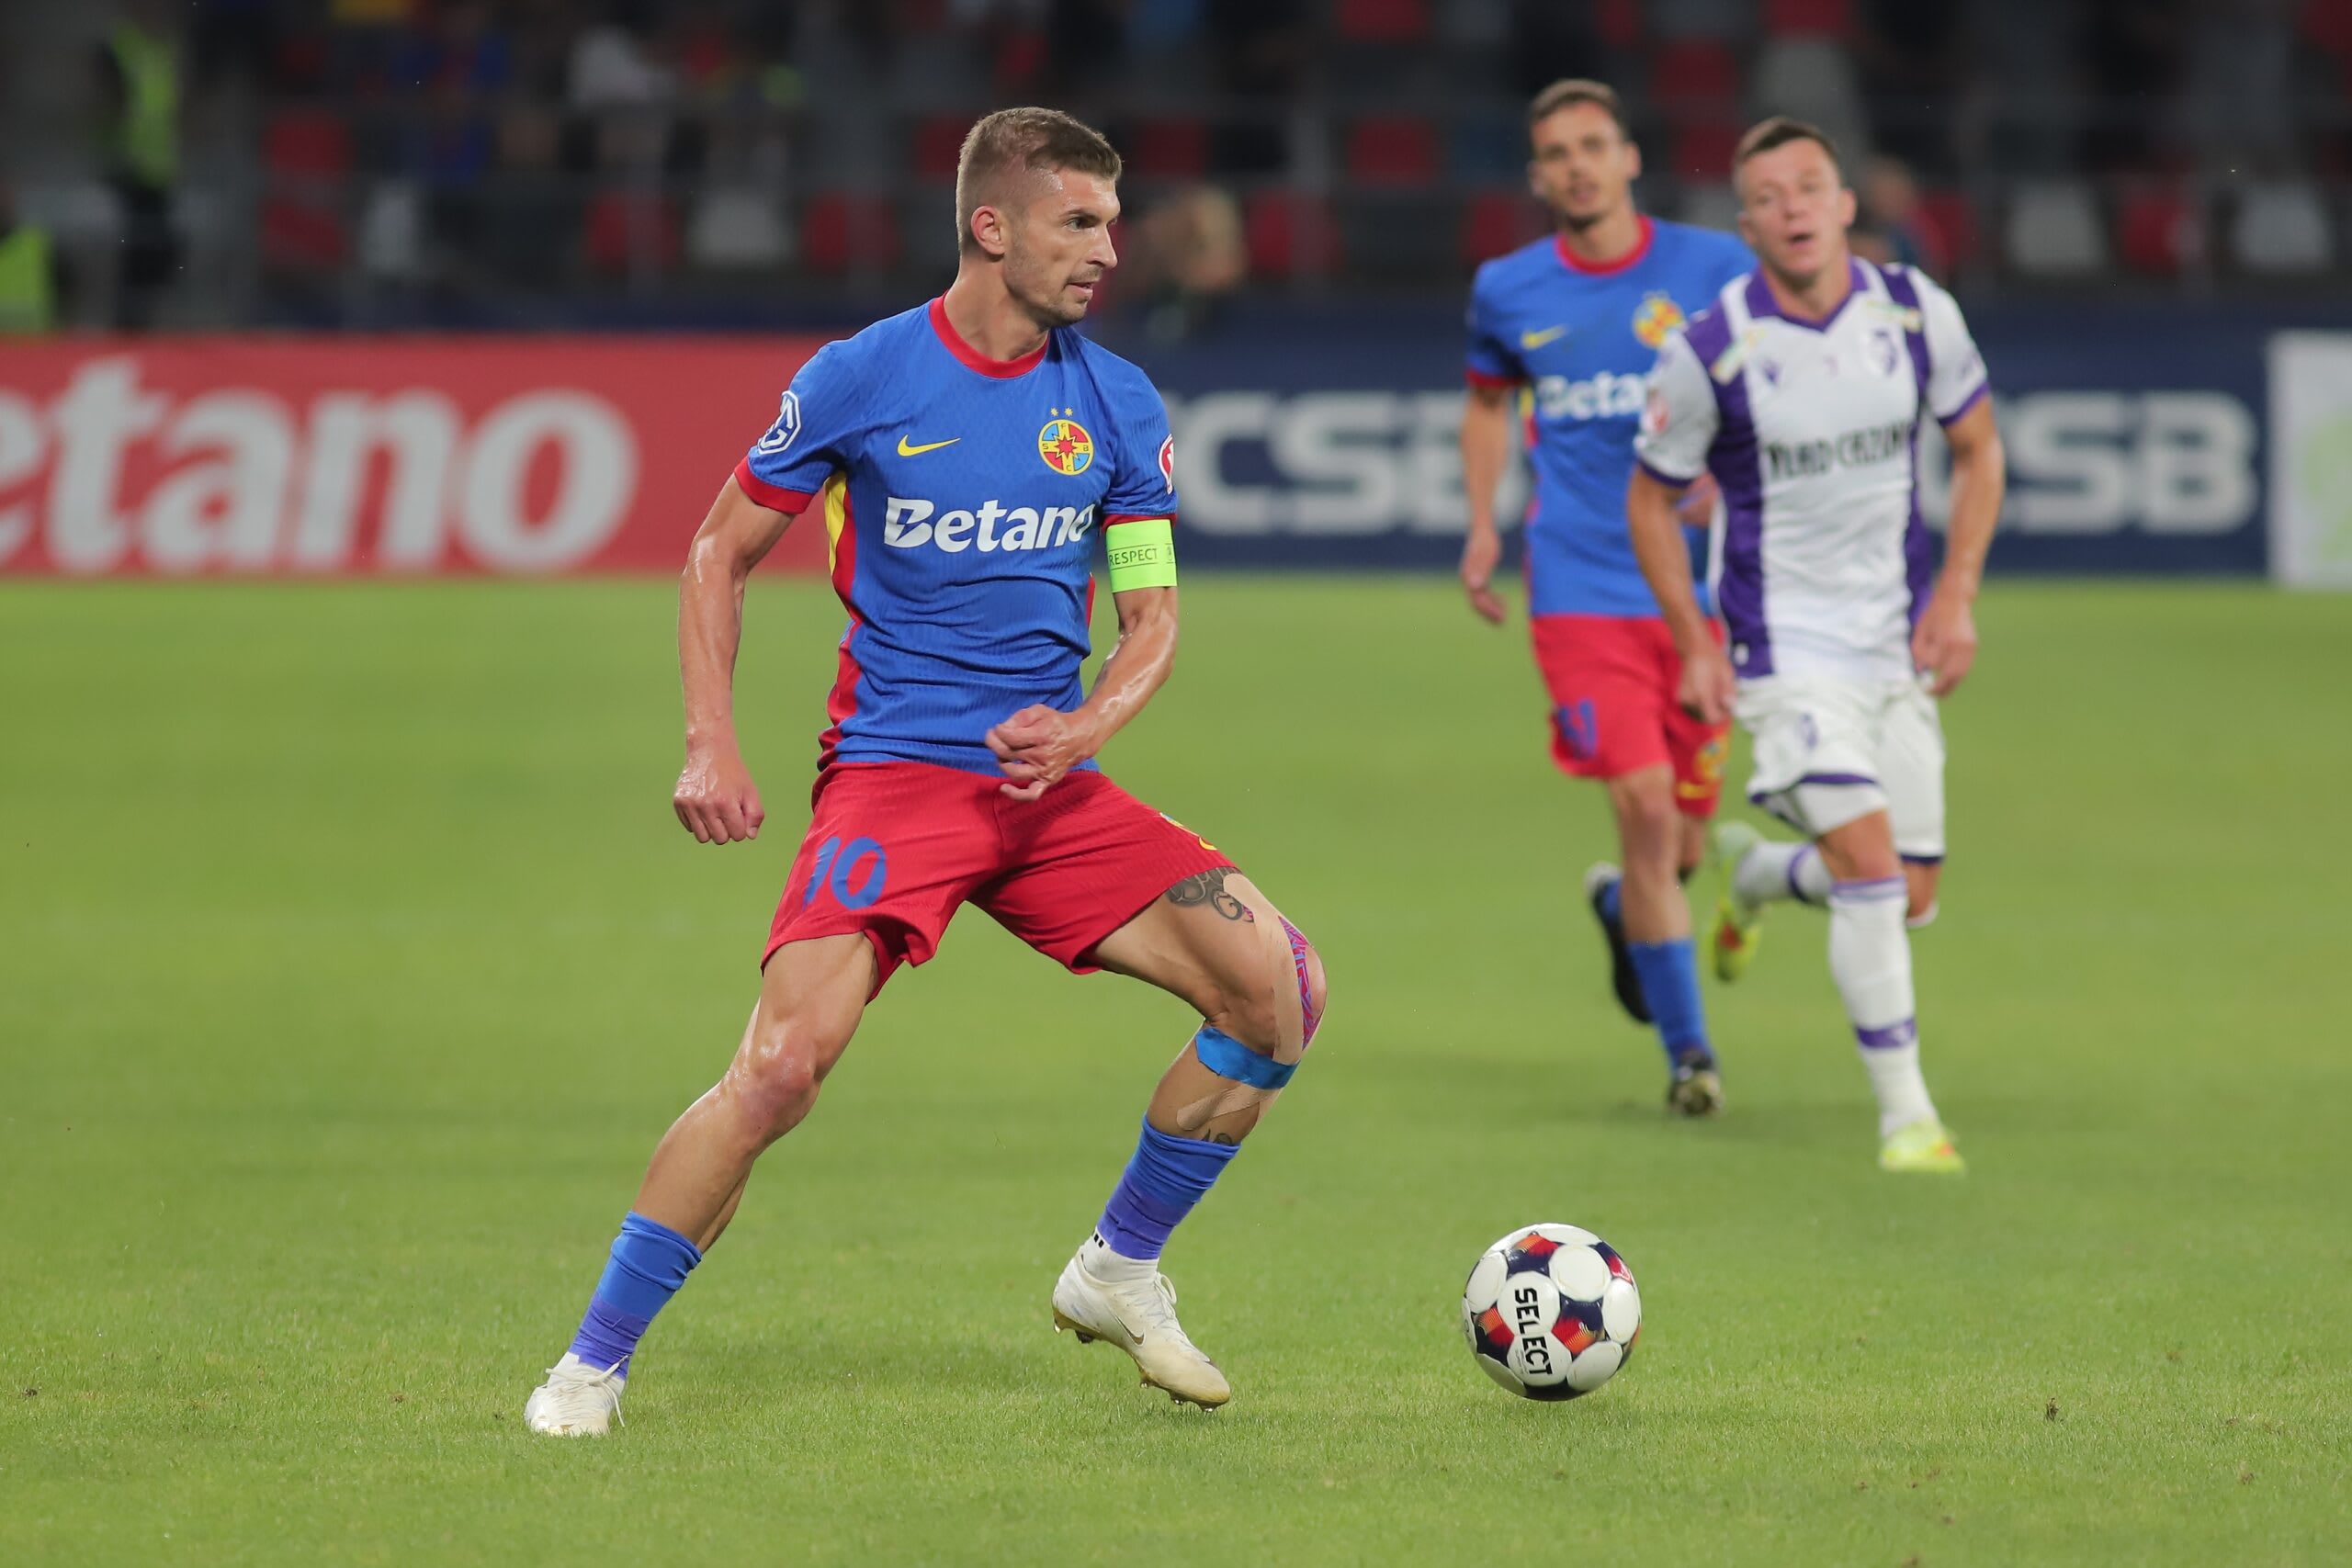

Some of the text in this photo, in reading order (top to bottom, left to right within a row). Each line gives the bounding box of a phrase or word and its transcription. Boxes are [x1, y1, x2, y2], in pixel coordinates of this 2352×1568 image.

[0, 355, 638, 571] tano
[1163, 389, 1529, 536] CSB
[884, 497, 1096, 553] Betano
[1108, 548, 1157, 566] RESPECT
[801, 835, 888, 911] 10
[1514, 1287, 1553, 1375] SELECT
